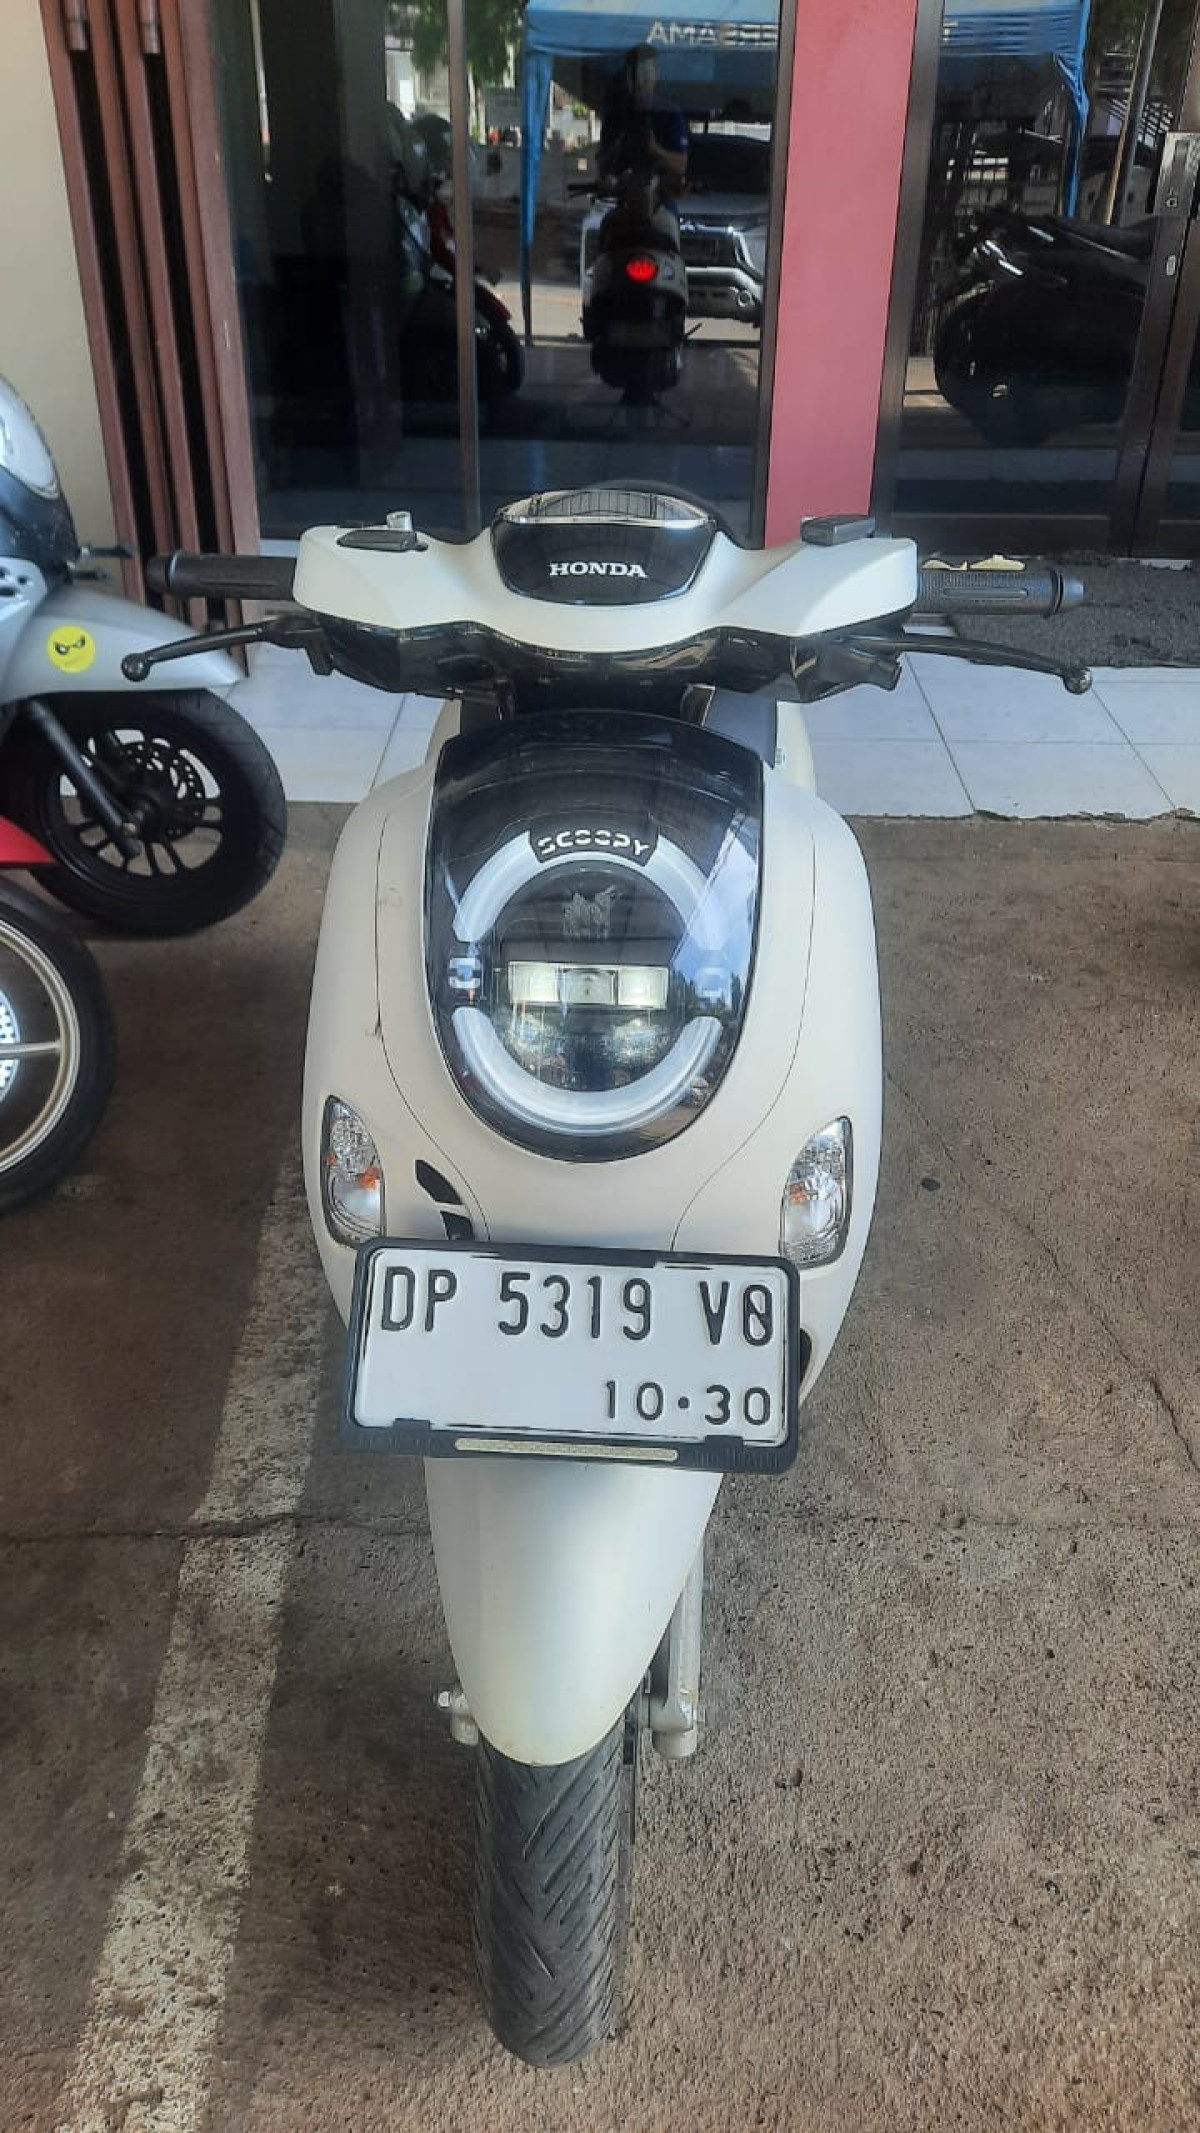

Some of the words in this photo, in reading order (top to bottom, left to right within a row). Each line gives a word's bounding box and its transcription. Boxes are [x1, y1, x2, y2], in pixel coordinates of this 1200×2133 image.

[549, 561, 648, 579] HONDA
[537, 829, 650, 856] SCOOPY
[381, 1266, 457, 1332] DP
[498, 1272, 652, 1341] 5319
